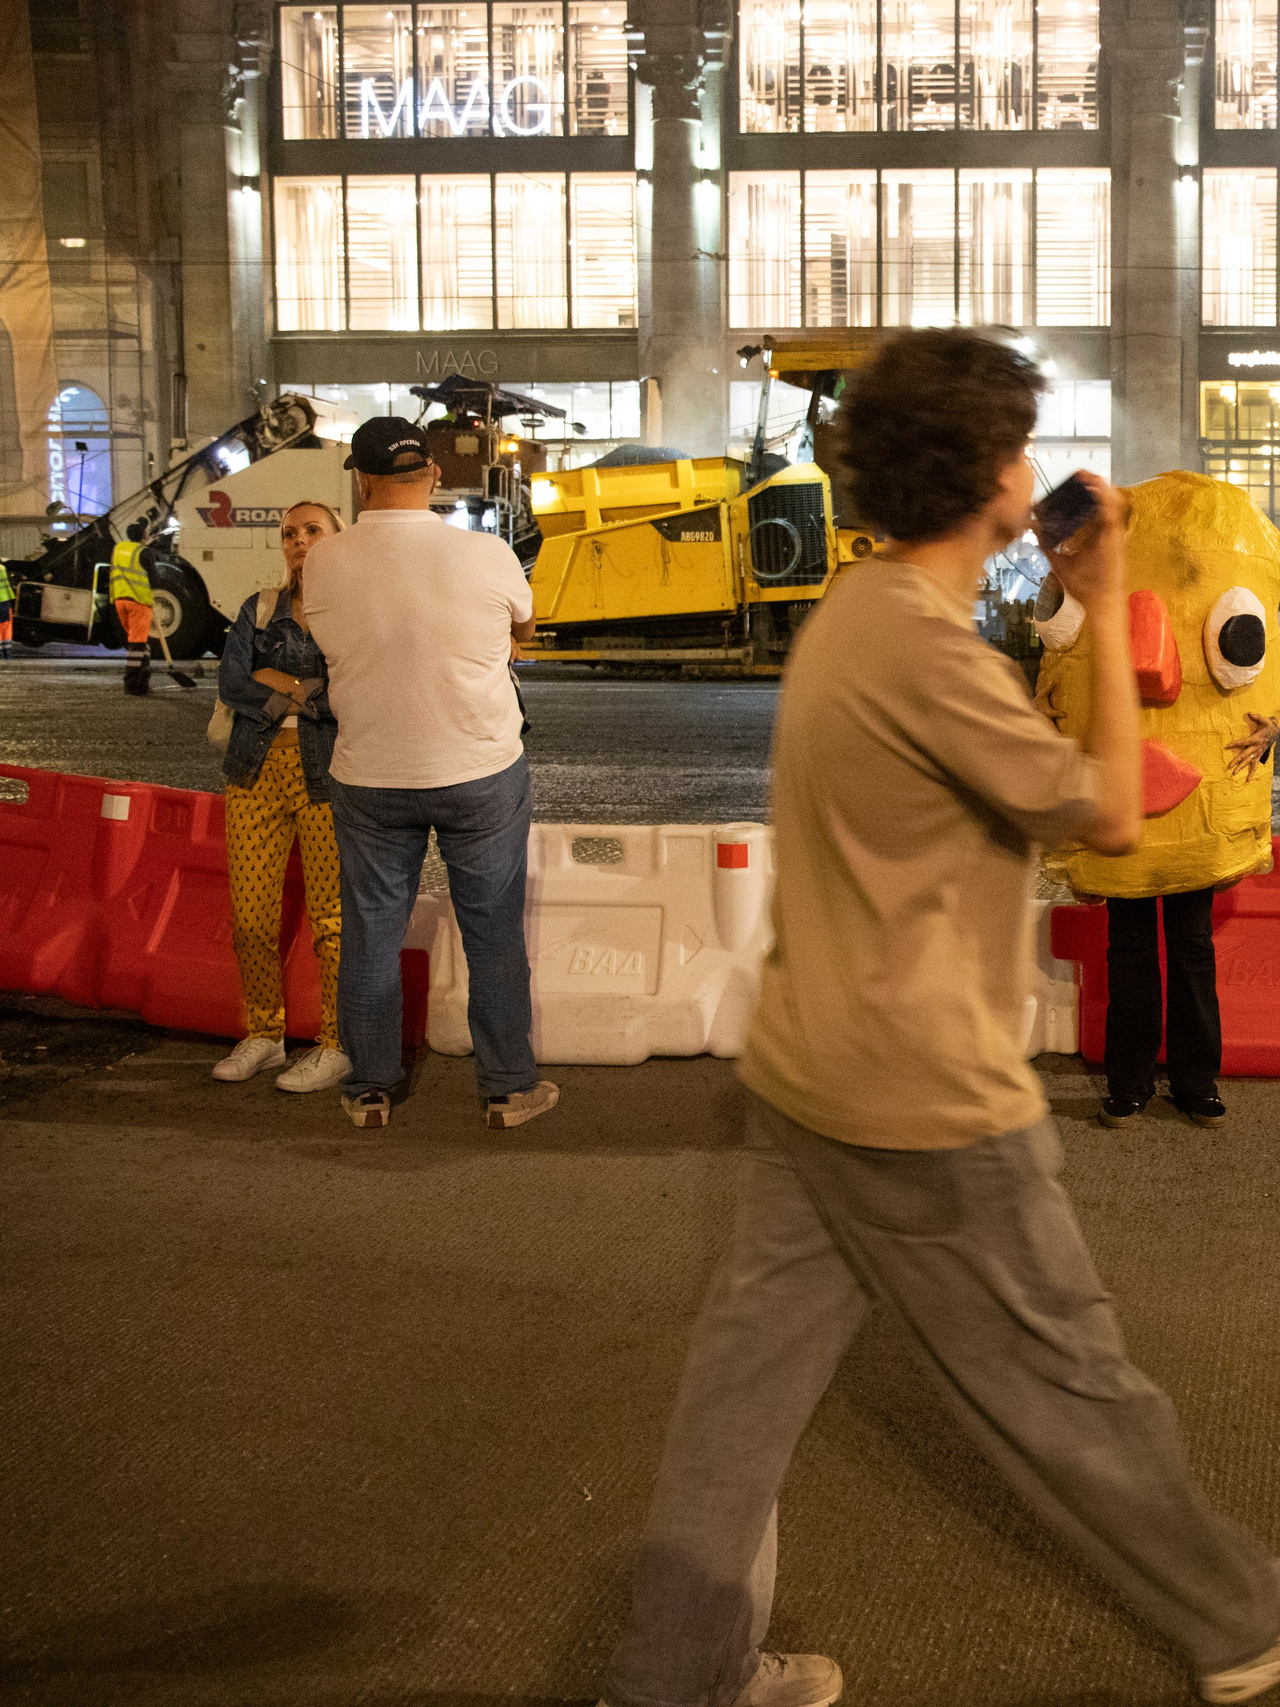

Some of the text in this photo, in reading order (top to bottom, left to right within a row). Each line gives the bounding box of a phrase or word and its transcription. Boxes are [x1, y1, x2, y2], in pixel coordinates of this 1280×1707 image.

[361, 75, 551, 138] MAAG
[417, 350, 499, 374] MAAG
[681, 531, 715, 542] ABG9820
